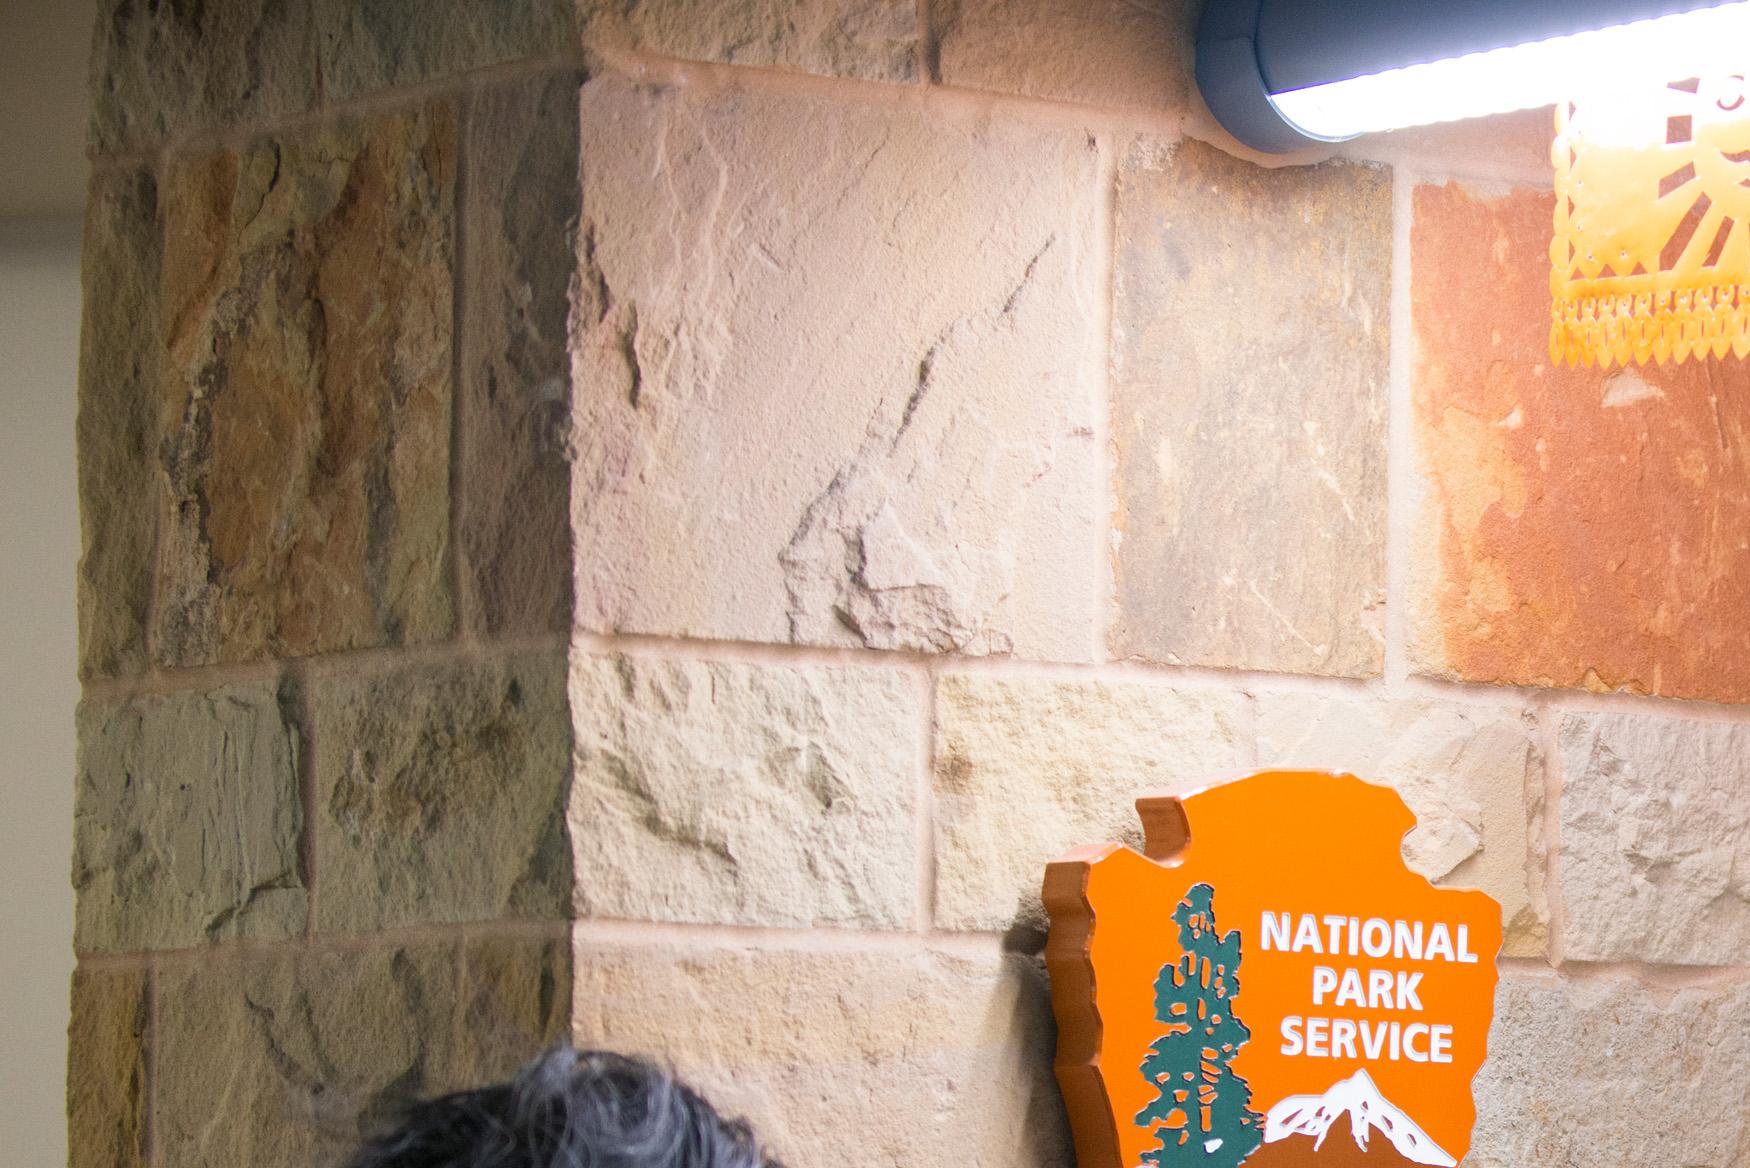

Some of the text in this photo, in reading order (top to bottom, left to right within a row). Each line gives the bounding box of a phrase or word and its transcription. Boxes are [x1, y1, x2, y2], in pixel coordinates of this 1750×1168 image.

[1260, 911, 1479, 963] NATIONAL
[1311, 966, 1424, 1010] PARK
[1279, 1016, 1453, 1063] SERVICE
